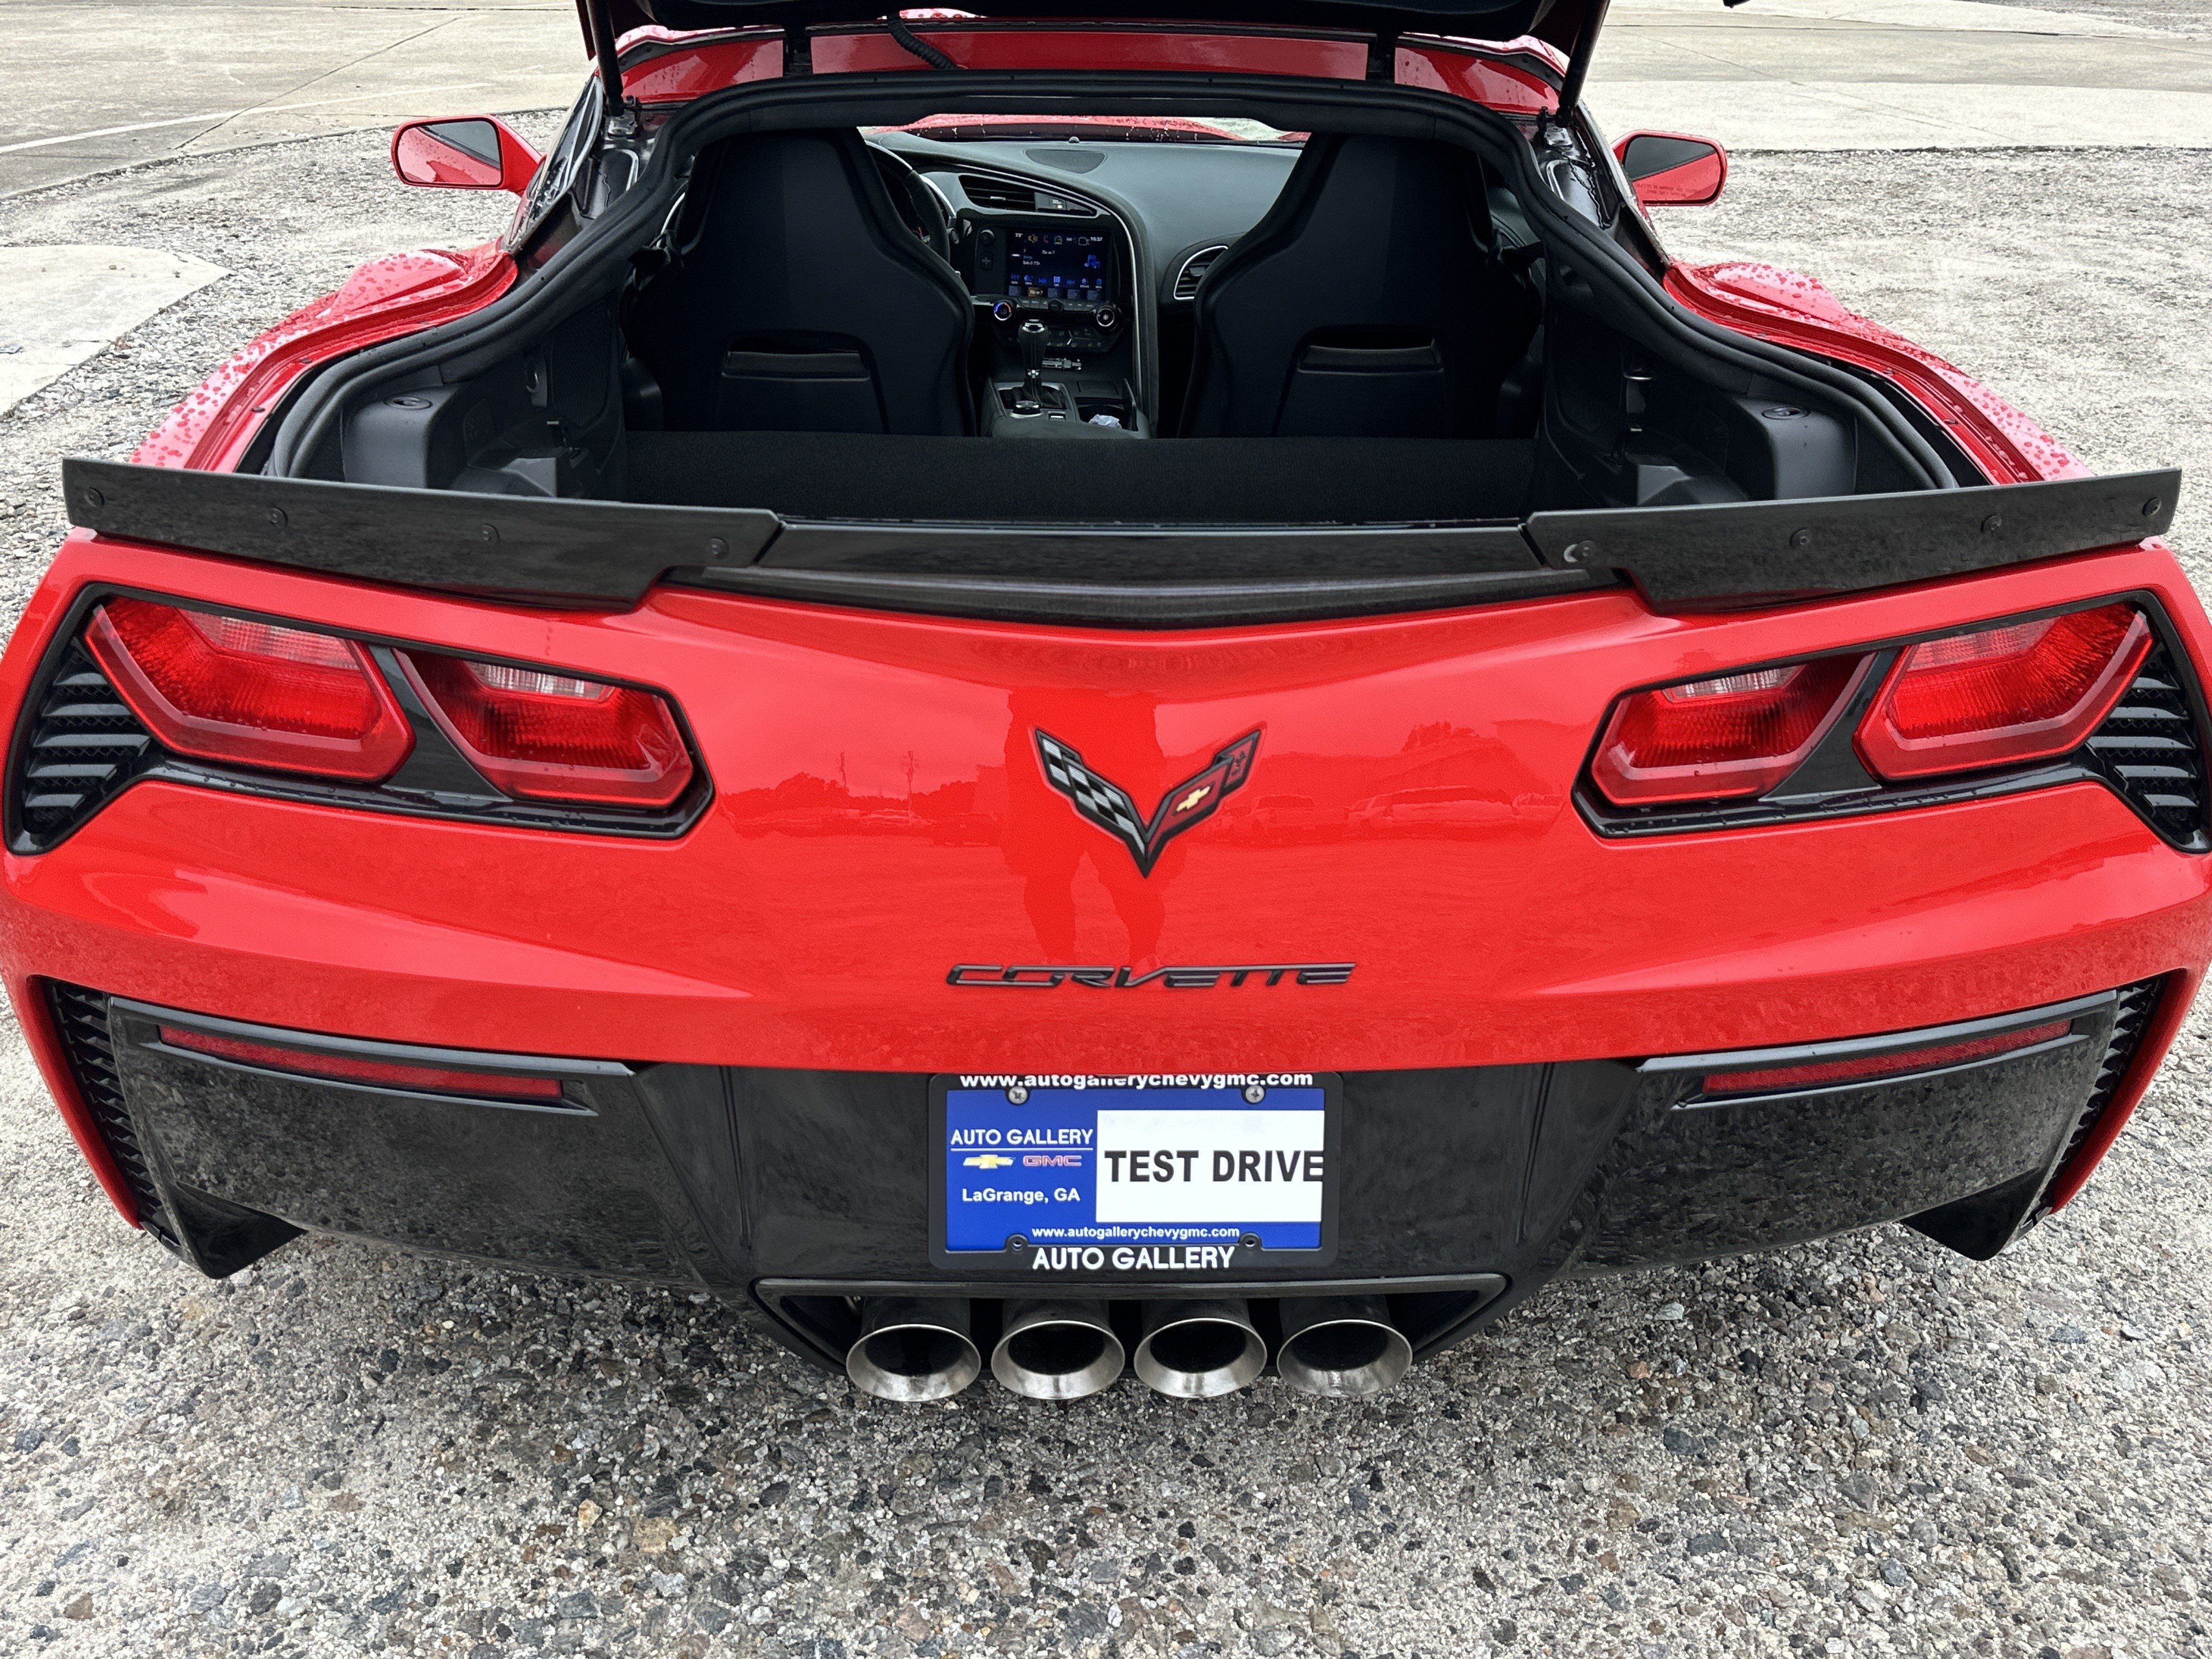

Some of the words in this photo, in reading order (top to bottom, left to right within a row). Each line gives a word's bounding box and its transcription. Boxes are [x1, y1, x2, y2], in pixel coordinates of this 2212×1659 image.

[946, 963, 1357, 988] CORVETTE
[951, 1129, 1002, 1145] AUTO
[1007, 1128, 1093, 1144] GALLERY
[1023, 1155, 1082, 1166] GMC
[1104, 1150, 1199, 1182] TEST
[1213, 1150, 1324, 1182] DRIVE
[962, 1188, 1048, 1204] LaGrange,
[1054, 1187, 1081, 1201] GA
[1032, 1226, 1240, 1240] www.autogallerychevygmc.com
[1032, 1247, 1104, 1269] AUTO
[1112, 1246, 1235, 1269] GALLERY
